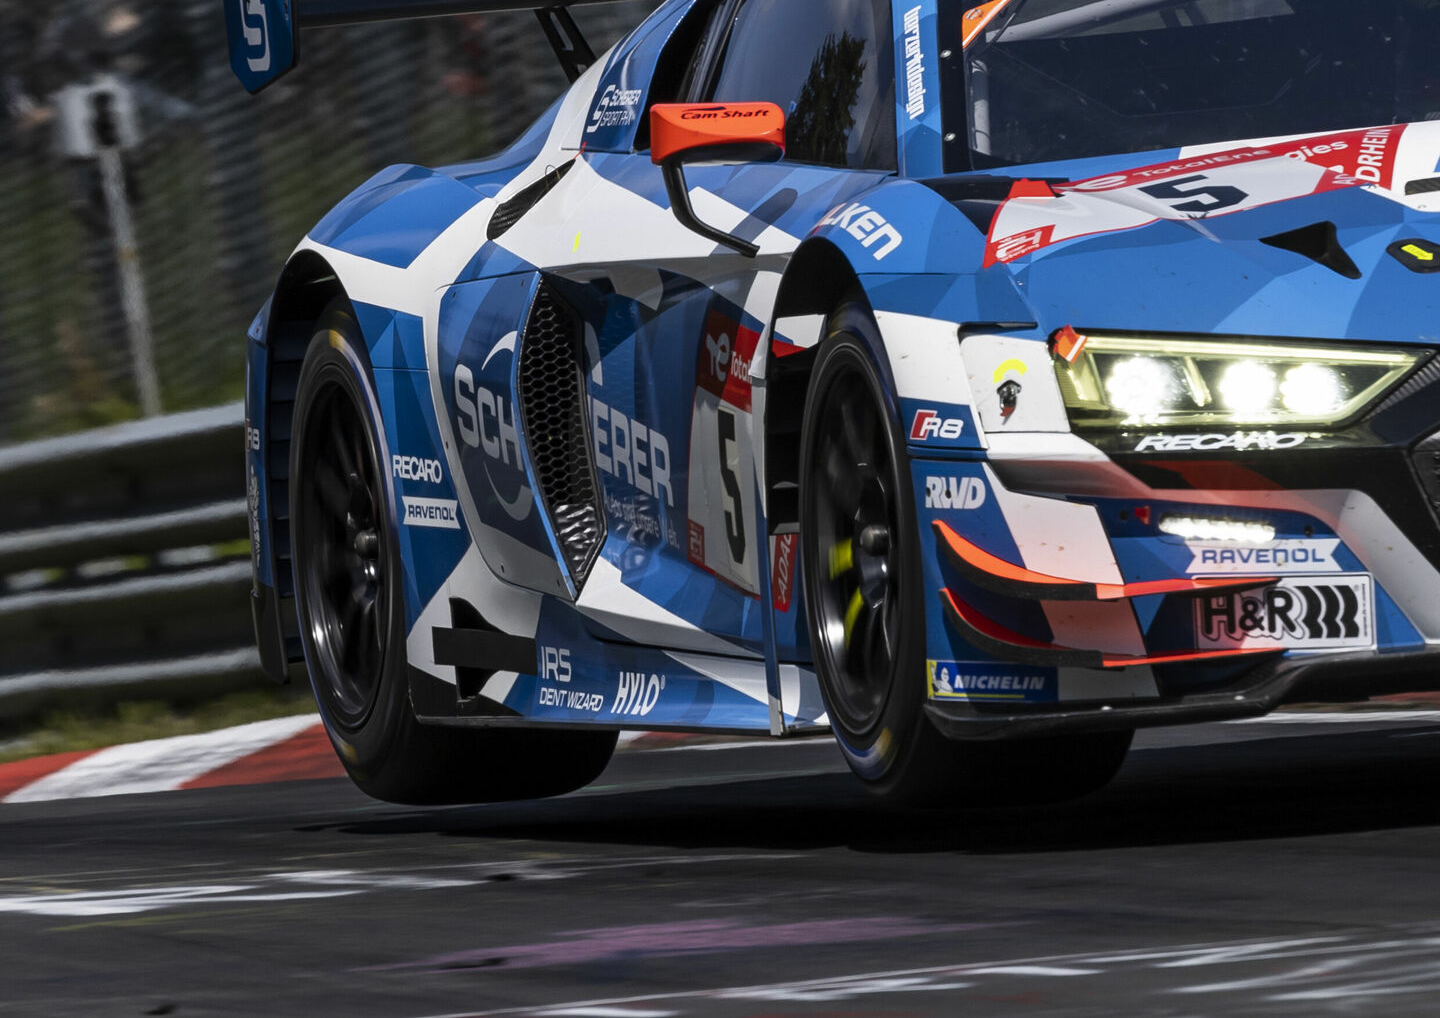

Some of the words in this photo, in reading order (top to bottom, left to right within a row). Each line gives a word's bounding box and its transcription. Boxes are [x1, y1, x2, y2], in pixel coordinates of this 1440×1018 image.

[681, 112, 717, 120] Cam
[721, 109, 770, 119] Shaft
[1137, 174, 1249, 212] 5
[818, 202, 903, 261] LKEN
[919, 416, 964, 440] R8
[1134, 432, 1306, 451] RECARO
[392, 454, 443, 484] RECARO
[717, 407, 746, 565] 5
[925, 476, 986, 509] RWD
[408, 504, 456, 522] RAVENOL
[1202, 547, 1326, 565] RAVENOL
[1202, 587, 1301, 638] H&R
[541, 645, 572, 683] IRS
[611, 670, 660, 717] HYLO
[954, 673, 1047, 691] MICHELIN
[539, 687, 567, 707] DENT
[567, 691, 604, 713] WIZARD
